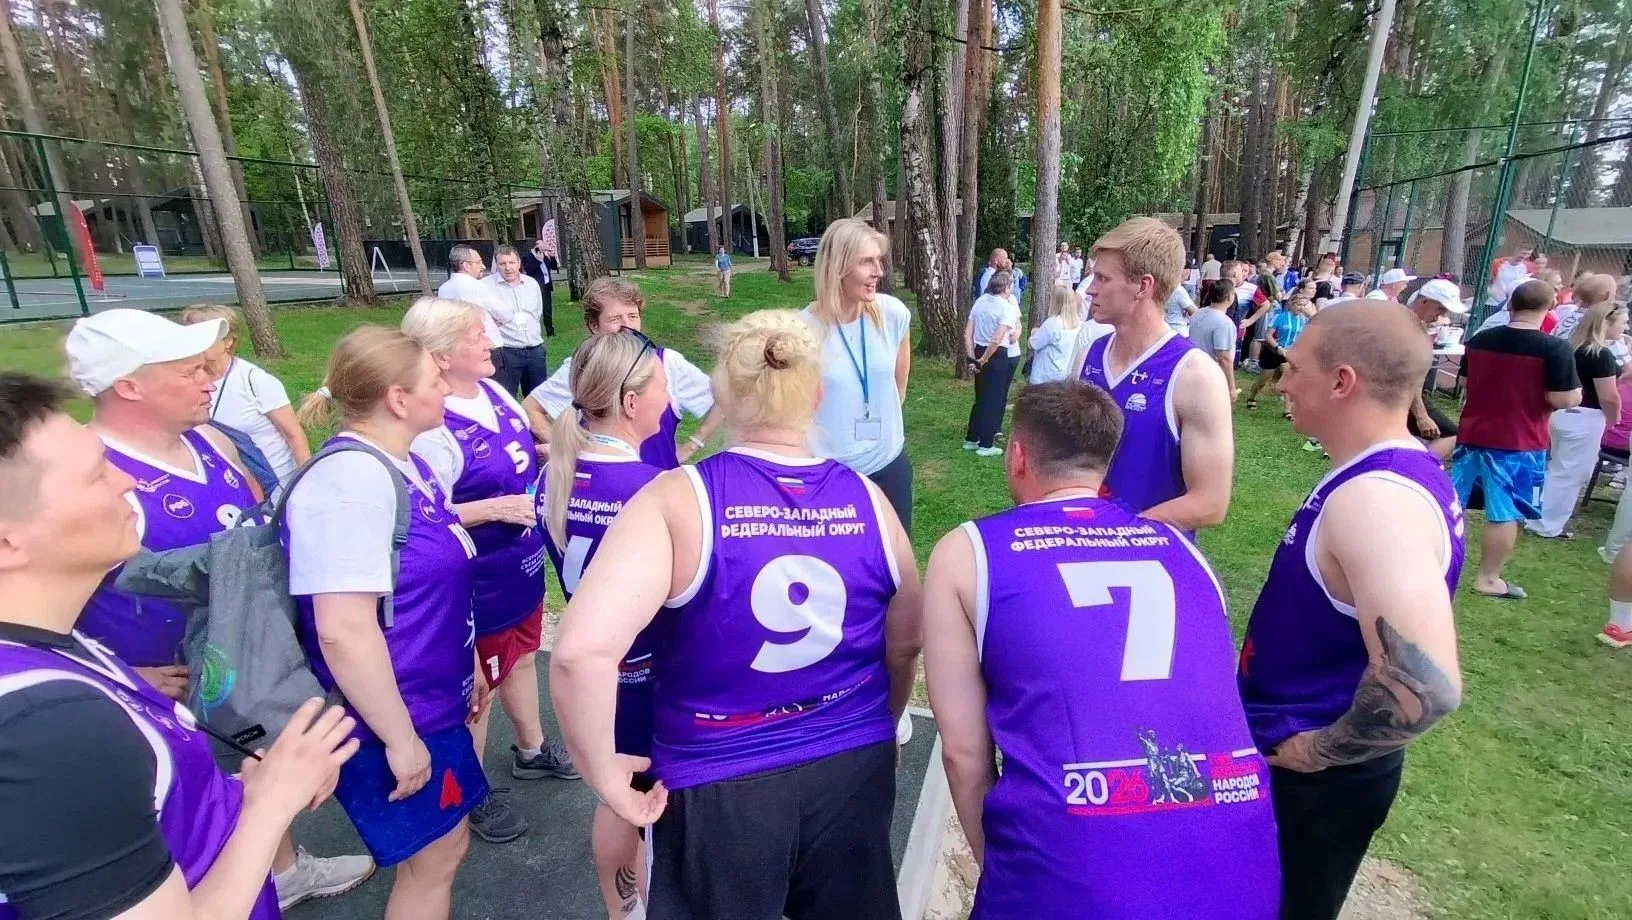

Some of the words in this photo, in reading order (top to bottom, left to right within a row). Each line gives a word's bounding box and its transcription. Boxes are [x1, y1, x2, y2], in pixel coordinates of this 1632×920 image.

[504, 440, 529, 474] 5
[725, 504, 857, 521] СЕВЕРО-ЗАПАДНЫЙ
[829, 522, 865, 535] ОКРУГ
[1014, 525, 1156, 538] СЕВЕРО-ЗАПАДНЫЙ
[1010, 536, 1131, 552] ФЕДЕРАЛЬНЫЙ
[1131, 537, 1170, 547] ОКРУГ
[750, 554, 847, 673] 9
[1056, 560, 1176, 681] 7
[486, 655, 500, 681] 1
[618, 668, 650, 677] АРОДОВ
[1064, 769, 1149, 805] 2026
[1215, 788, 1260, 804] РОССИИ
